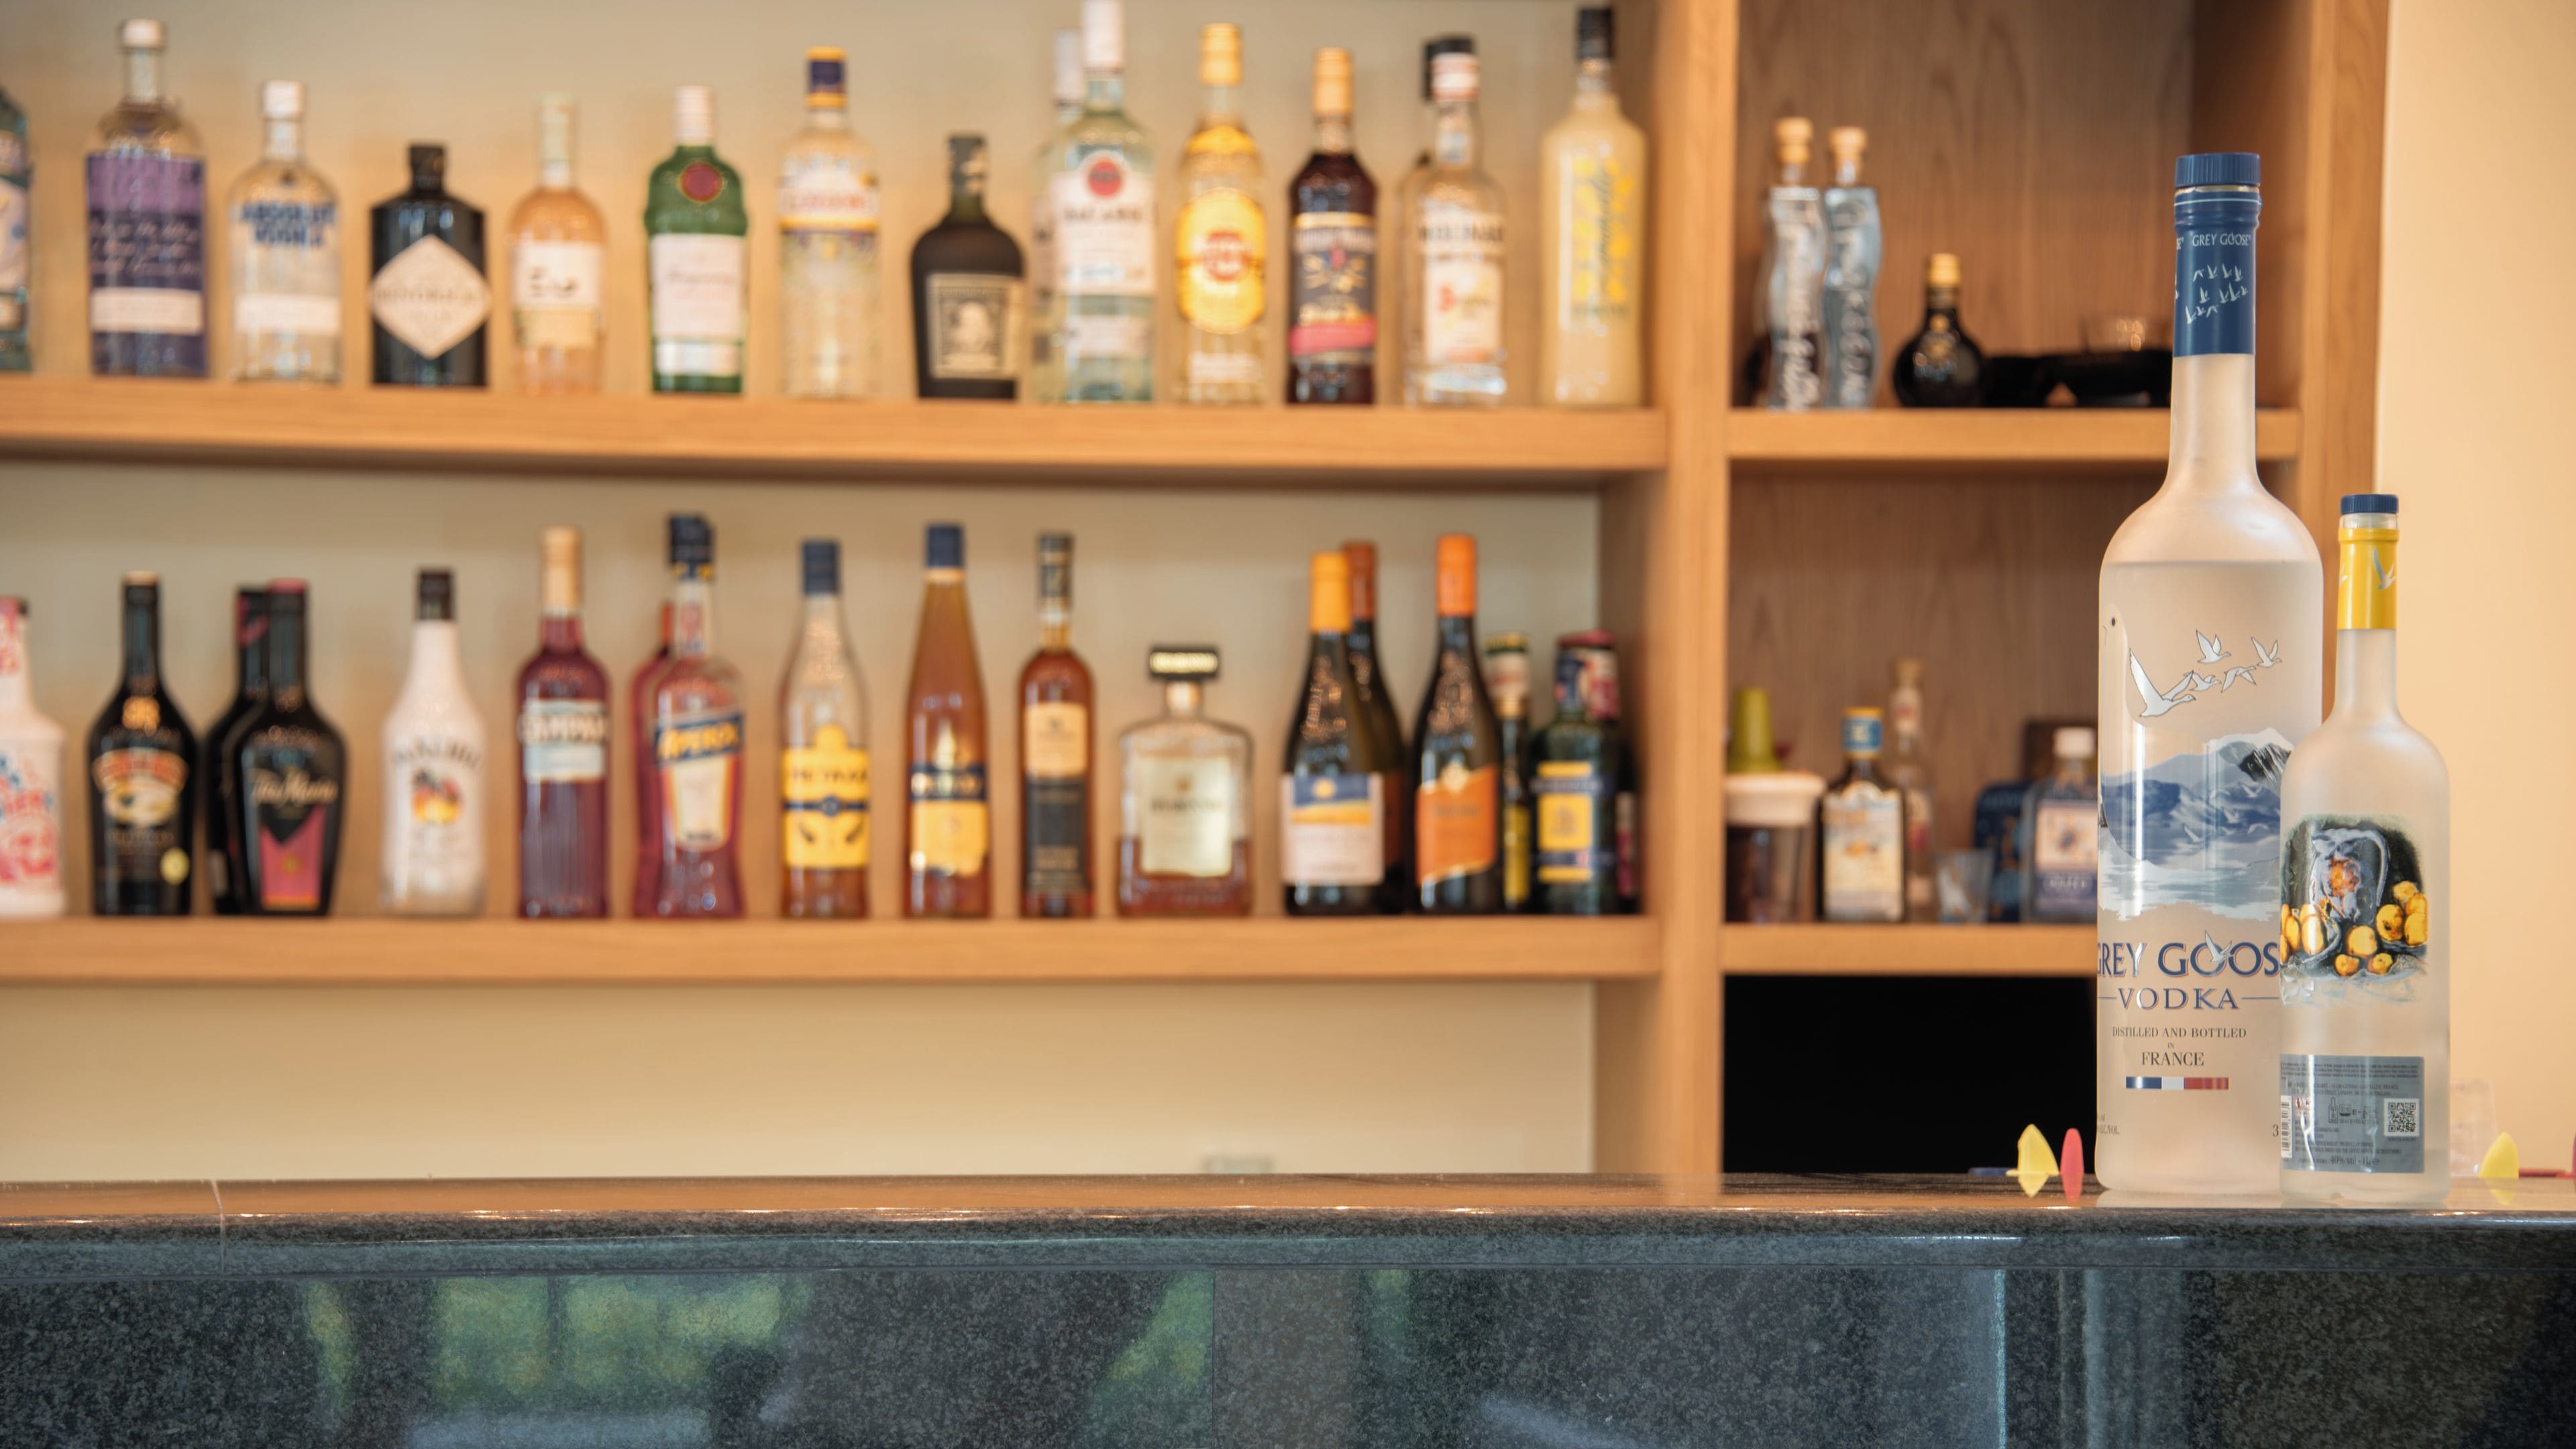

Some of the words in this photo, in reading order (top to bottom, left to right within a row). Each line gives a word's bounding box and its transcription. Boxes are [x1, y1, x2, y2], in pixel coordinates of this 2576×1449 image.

[2192, 233, 2217, 247] GREY
[2220, 232, 2249, 246] GOOSE
[2157, 941, 2280, 977] GOOS
[2117, 987, 2240, 1010] VODKA
[2112, 1026, 2159, 1038] DISTILLED
[2162, 1028, 2187, 1038] AND
[2191, 1027, 2247, 1038] BOTTLED
[2141, 1051, 2205, 1067] FRANCE
